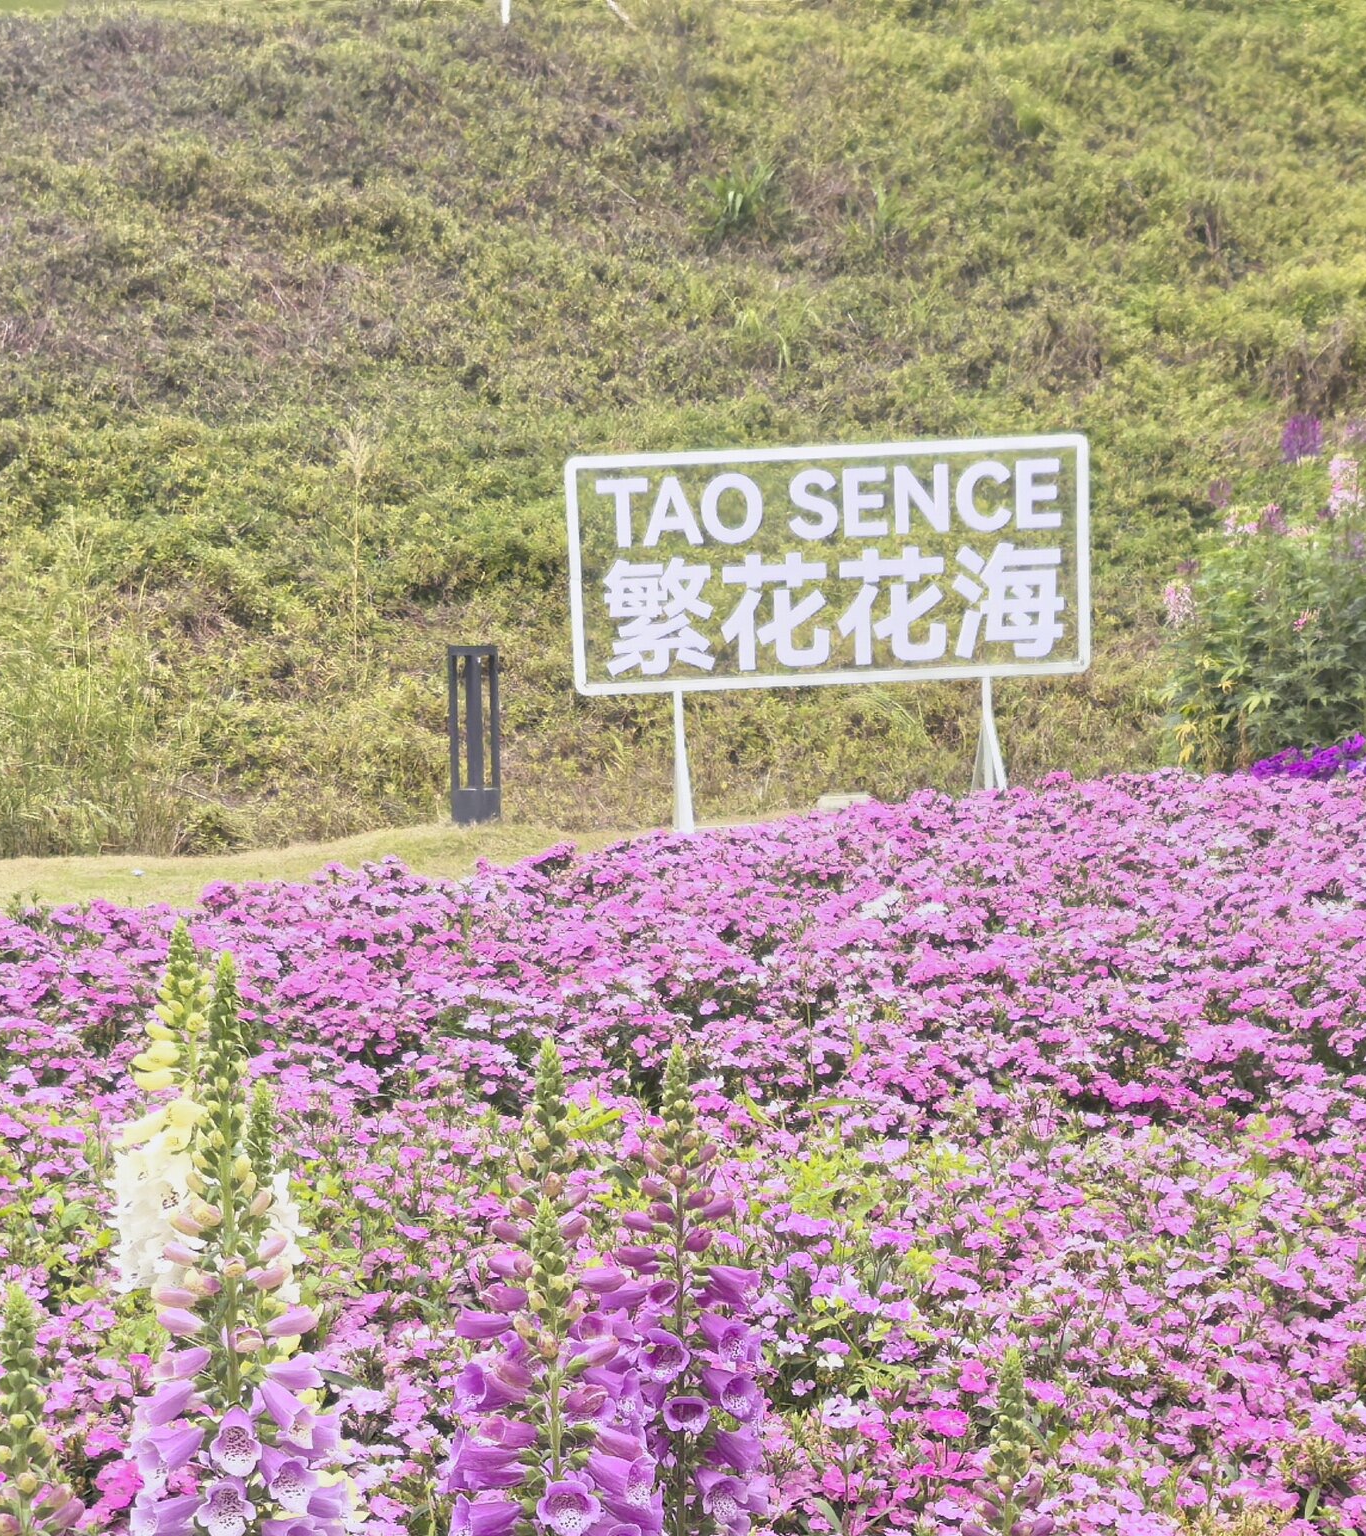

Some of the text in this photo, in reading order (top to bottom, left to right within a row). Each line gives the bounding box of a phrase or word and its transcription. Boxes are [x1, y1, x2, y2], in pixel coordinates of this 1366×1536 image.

[596, 459, 1062, 548] TAO SENCE
[603, 543, 1064, 676] 繁花花海
